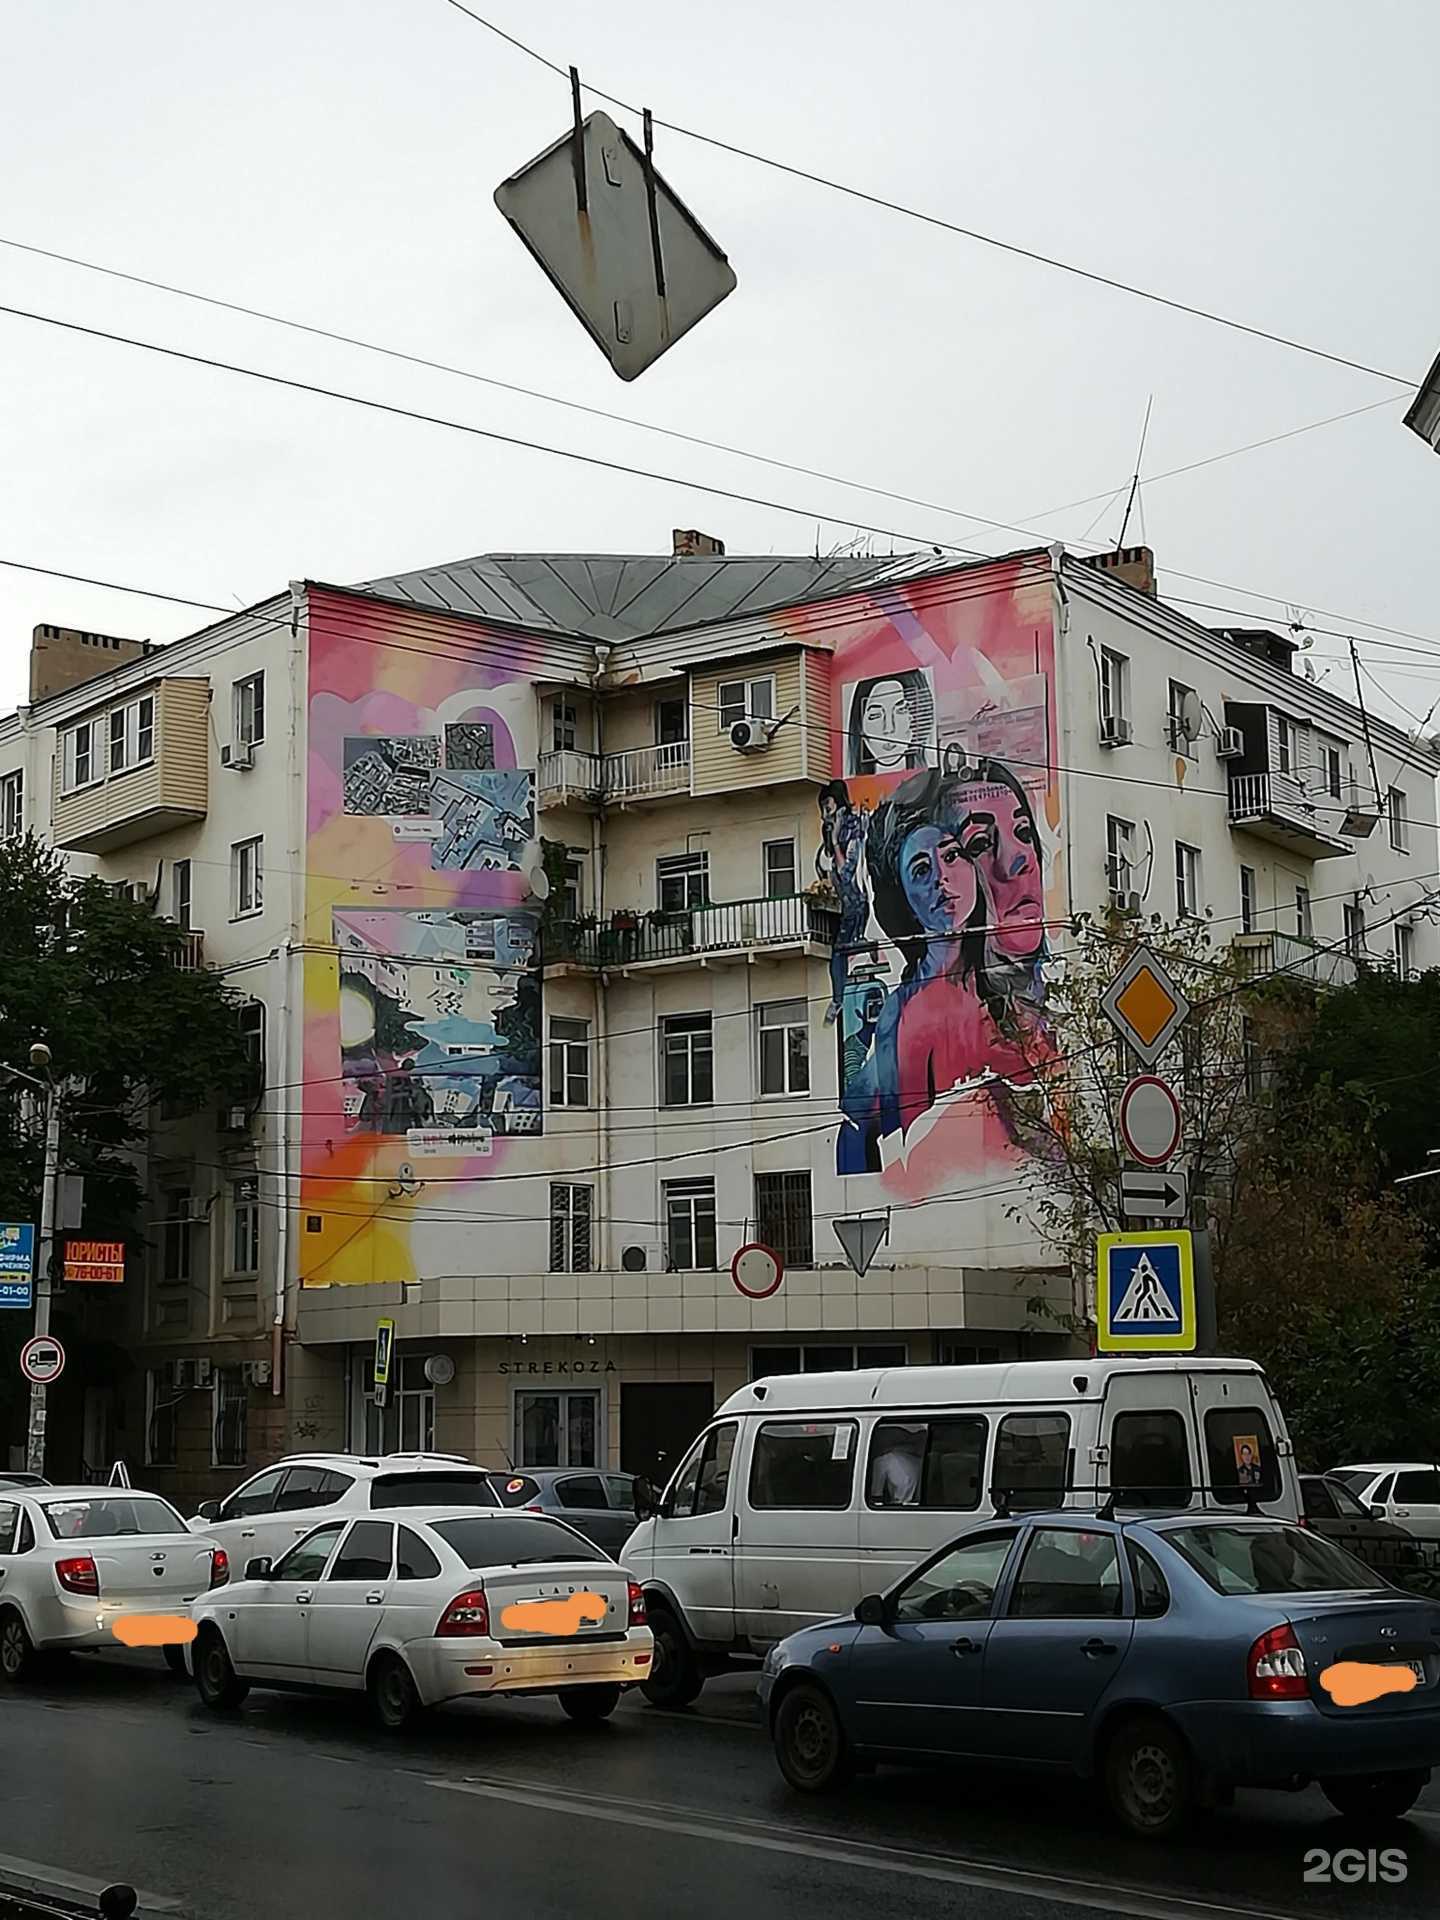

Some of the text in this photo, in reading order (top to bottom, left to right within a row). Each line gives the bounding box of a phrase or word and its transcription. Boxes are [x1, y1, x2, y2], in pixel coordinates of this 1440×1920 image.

[66, 1241, 123, 1262] ЮРИСТЫ
[498, 1360, 617, 1375] STREKOZA
[538, 1586, 590, 1596] LADA
